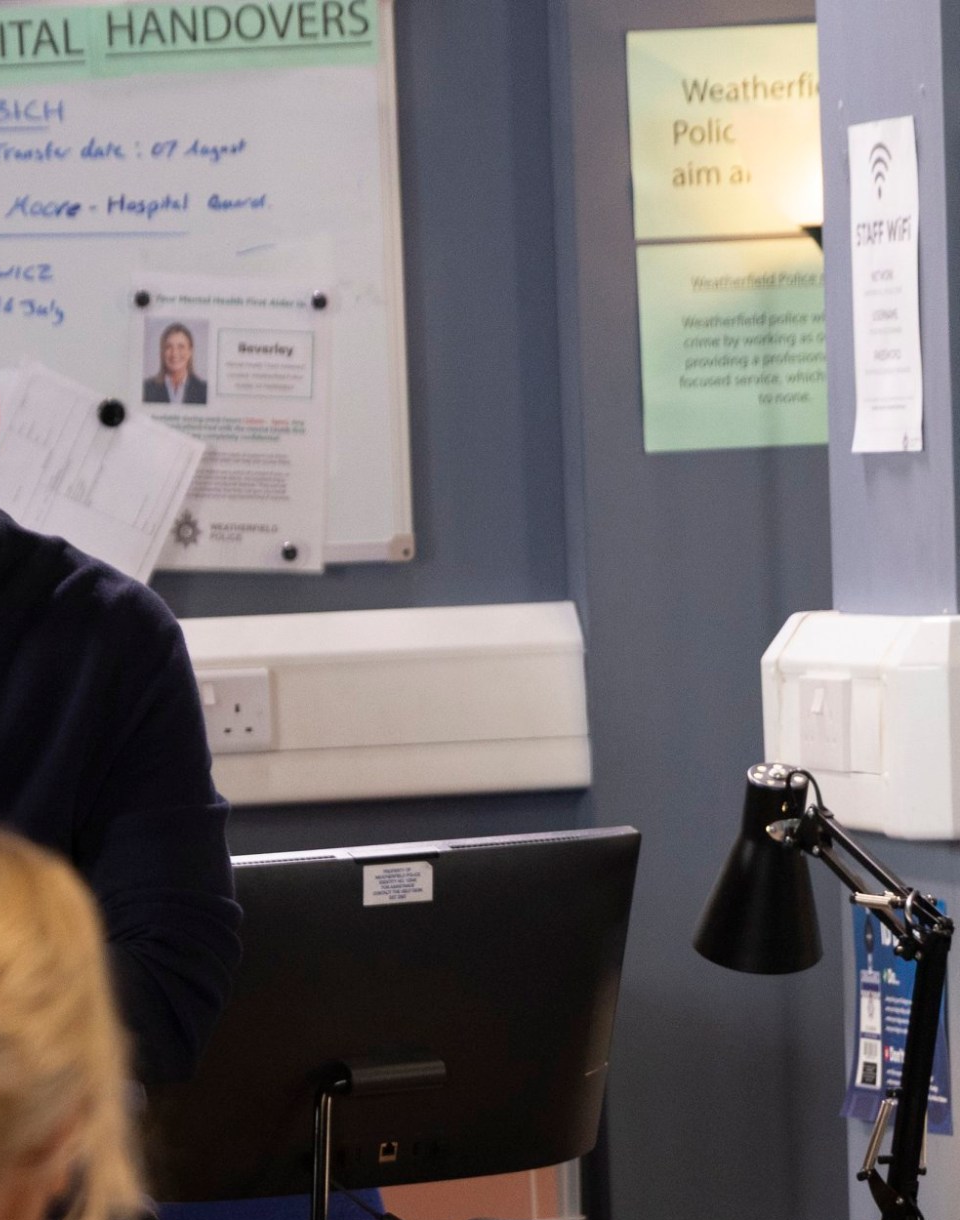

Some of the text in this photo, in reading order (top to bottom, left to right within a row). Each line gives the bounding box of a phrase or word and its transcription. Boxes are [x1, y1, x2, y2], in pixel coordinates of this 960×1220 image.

[107, 1, 371, 48] HANDOVERS
[673, 161, 721, 187] aim
[857, 213, 912, 247] STAFF WiFi
[238, 341, 294, 358] Beverley
